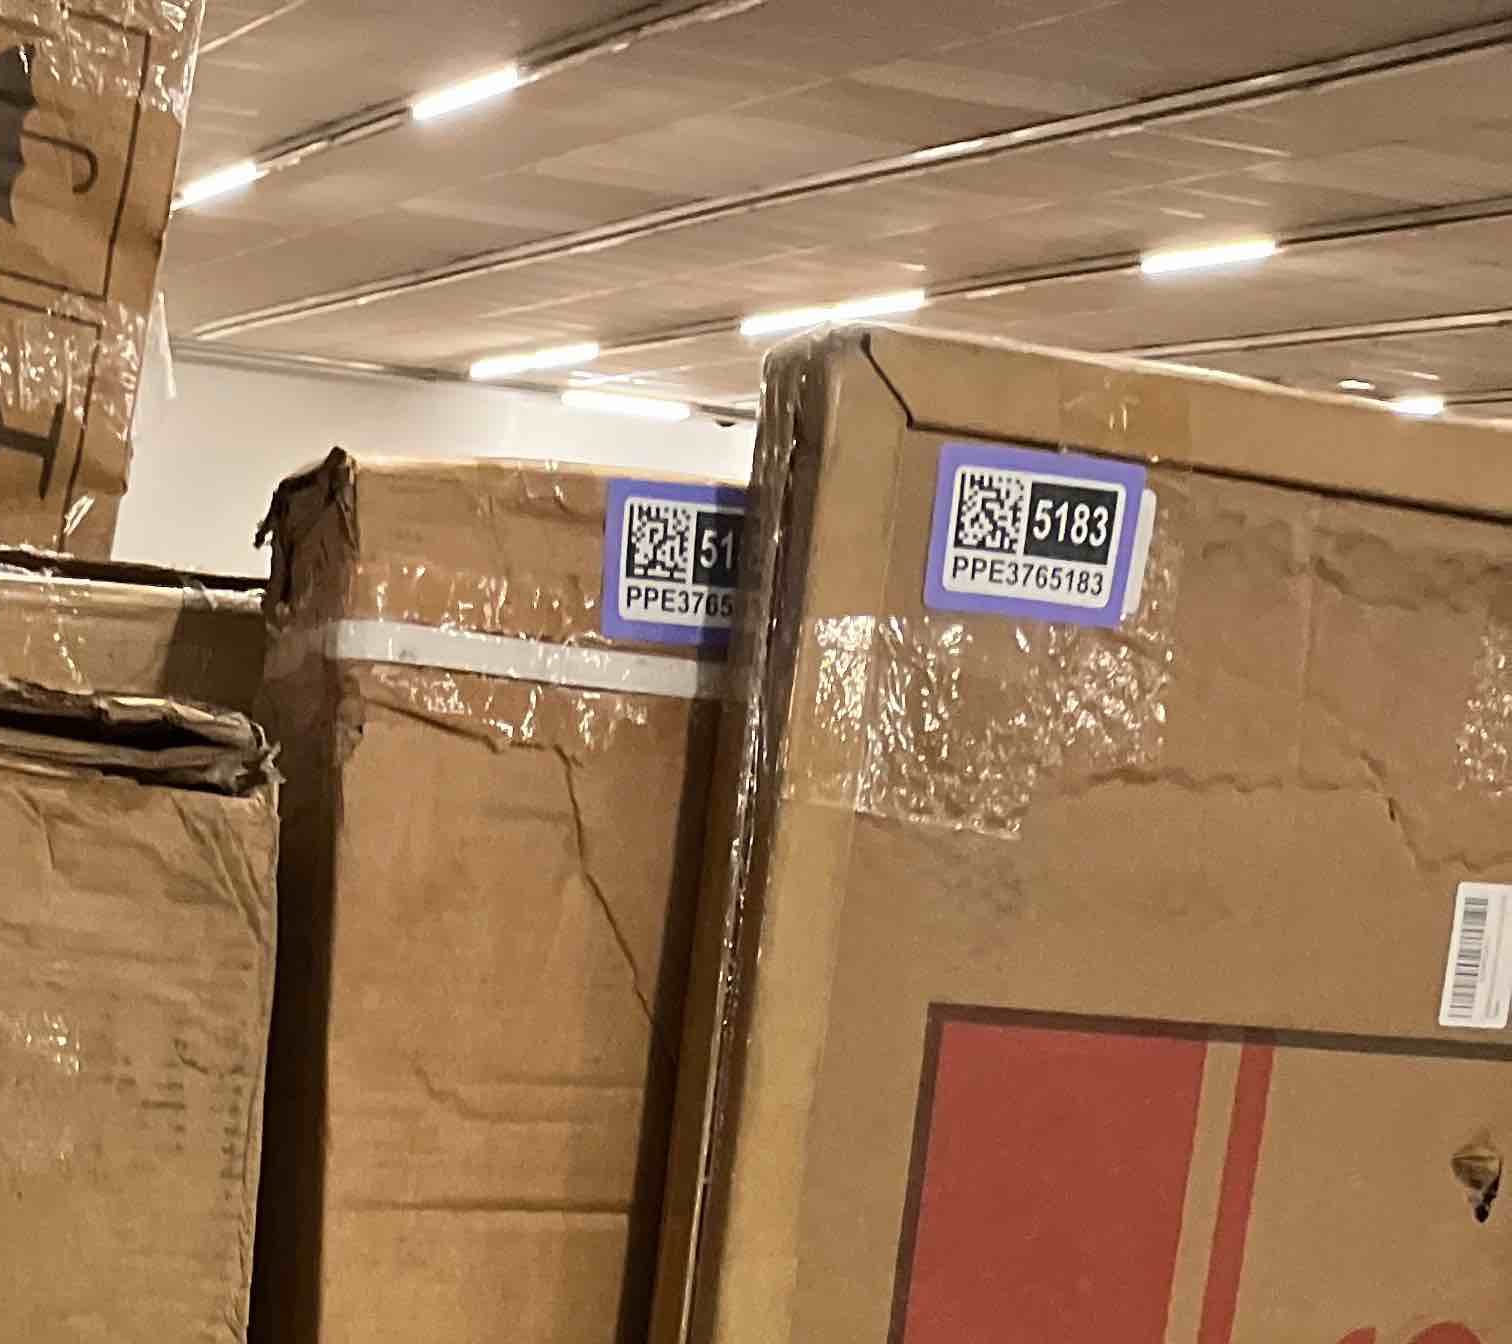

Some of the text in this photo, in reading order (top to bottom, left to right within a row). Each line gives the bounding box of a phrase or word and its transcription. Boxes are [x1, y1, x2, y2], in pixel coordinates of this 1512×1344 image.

[1032, 500, 1109, 547] 5183
[700, 529, 735, 570] 51
[952, 556, 1104, 596] PPE3765183
[626, 586, 734, 617] PPE3765
